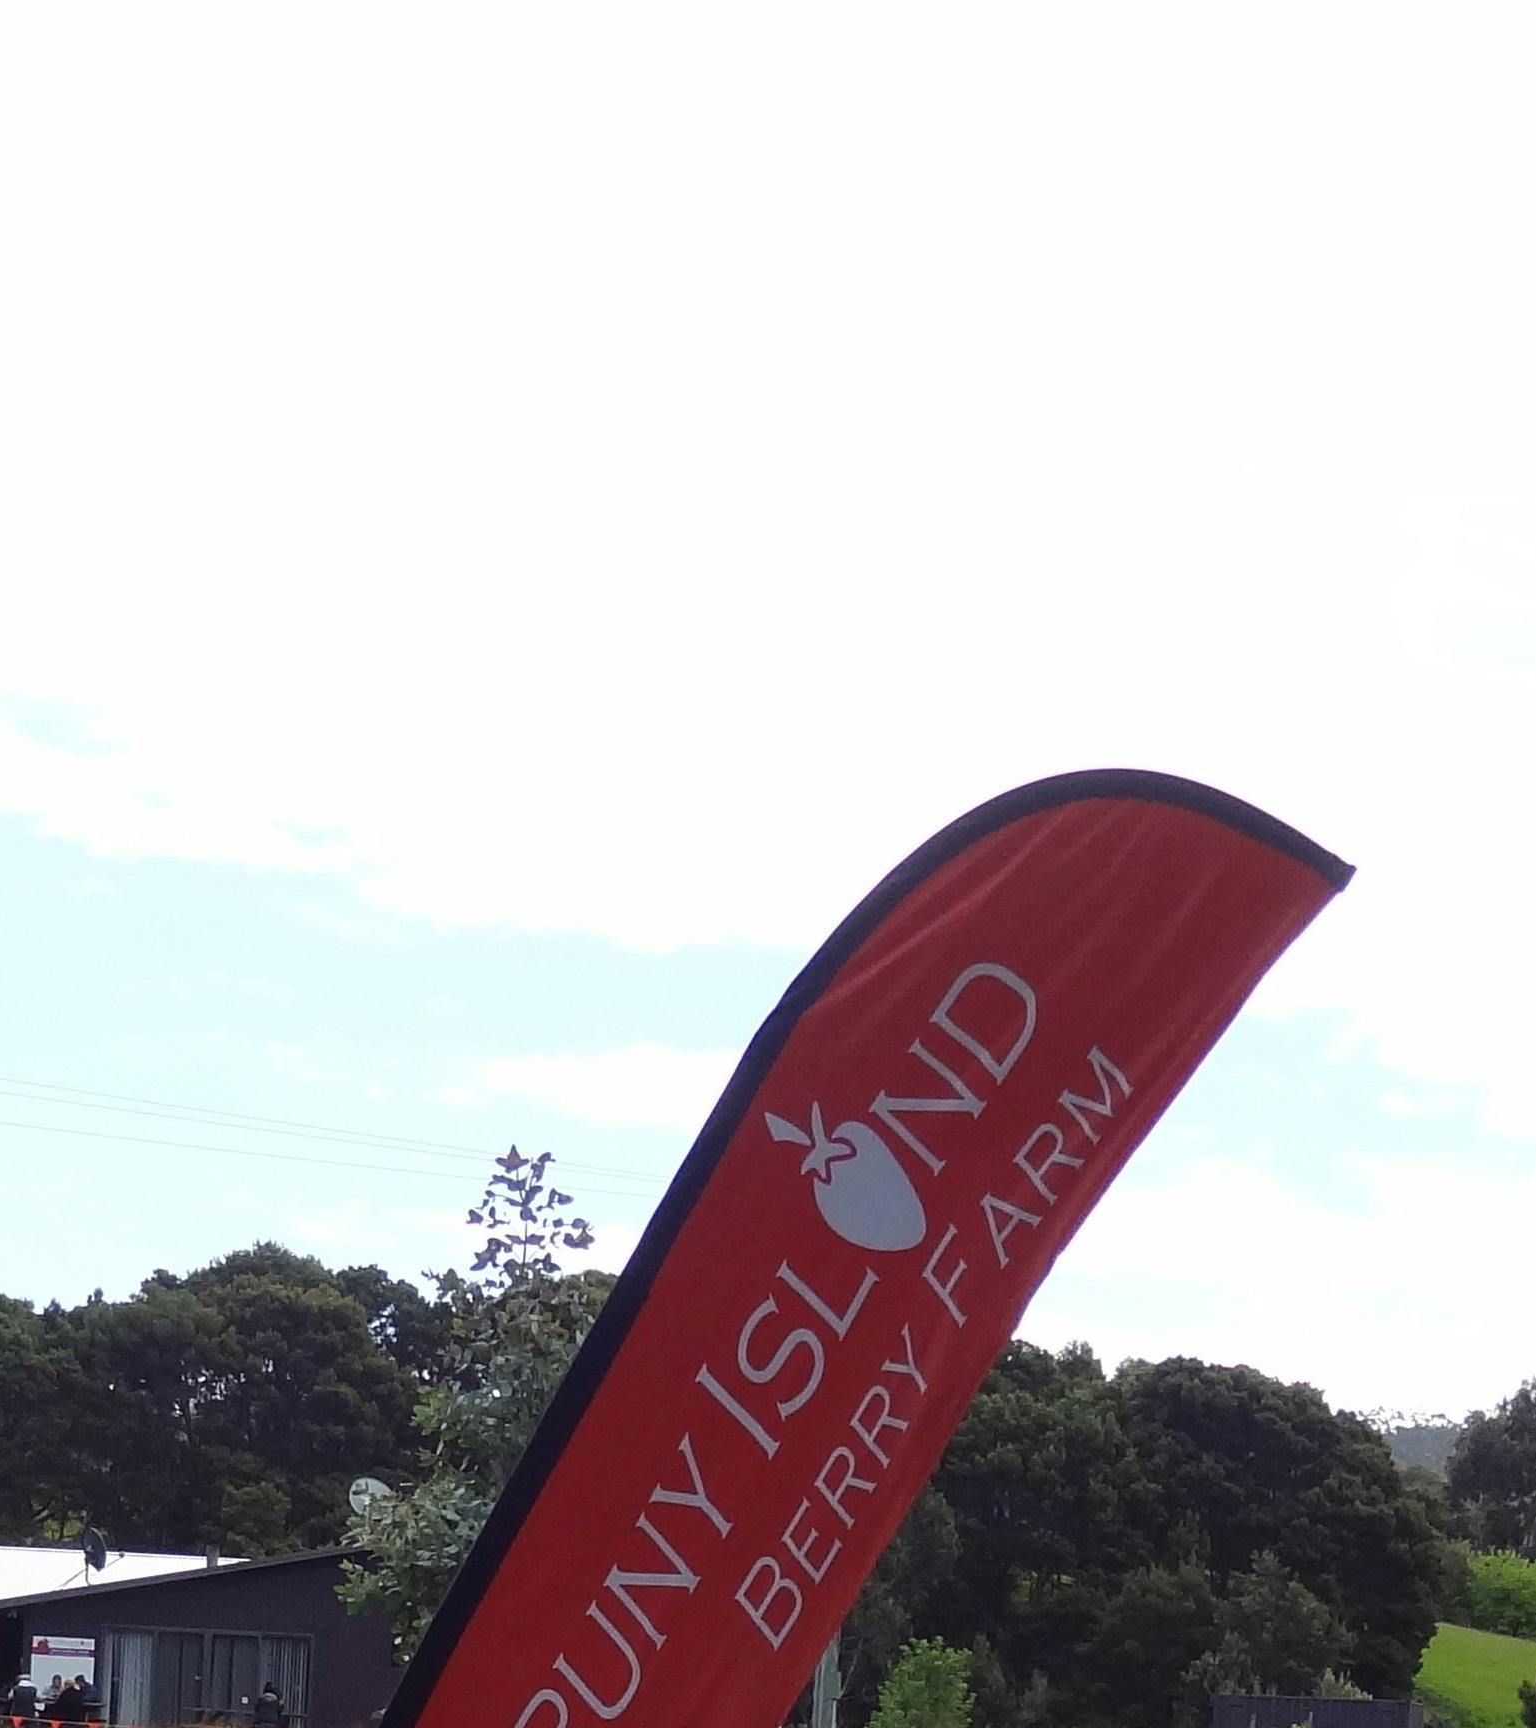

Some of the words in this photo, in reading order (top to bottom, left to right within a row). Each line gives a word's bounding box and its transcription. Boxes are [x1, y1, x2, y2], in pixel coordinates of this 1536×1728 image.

[696, 961, 1040, 1459] ISLND
[733, 1330, 929, 1652] BERRY
[921, 1045, 1135, 1327] FARM
